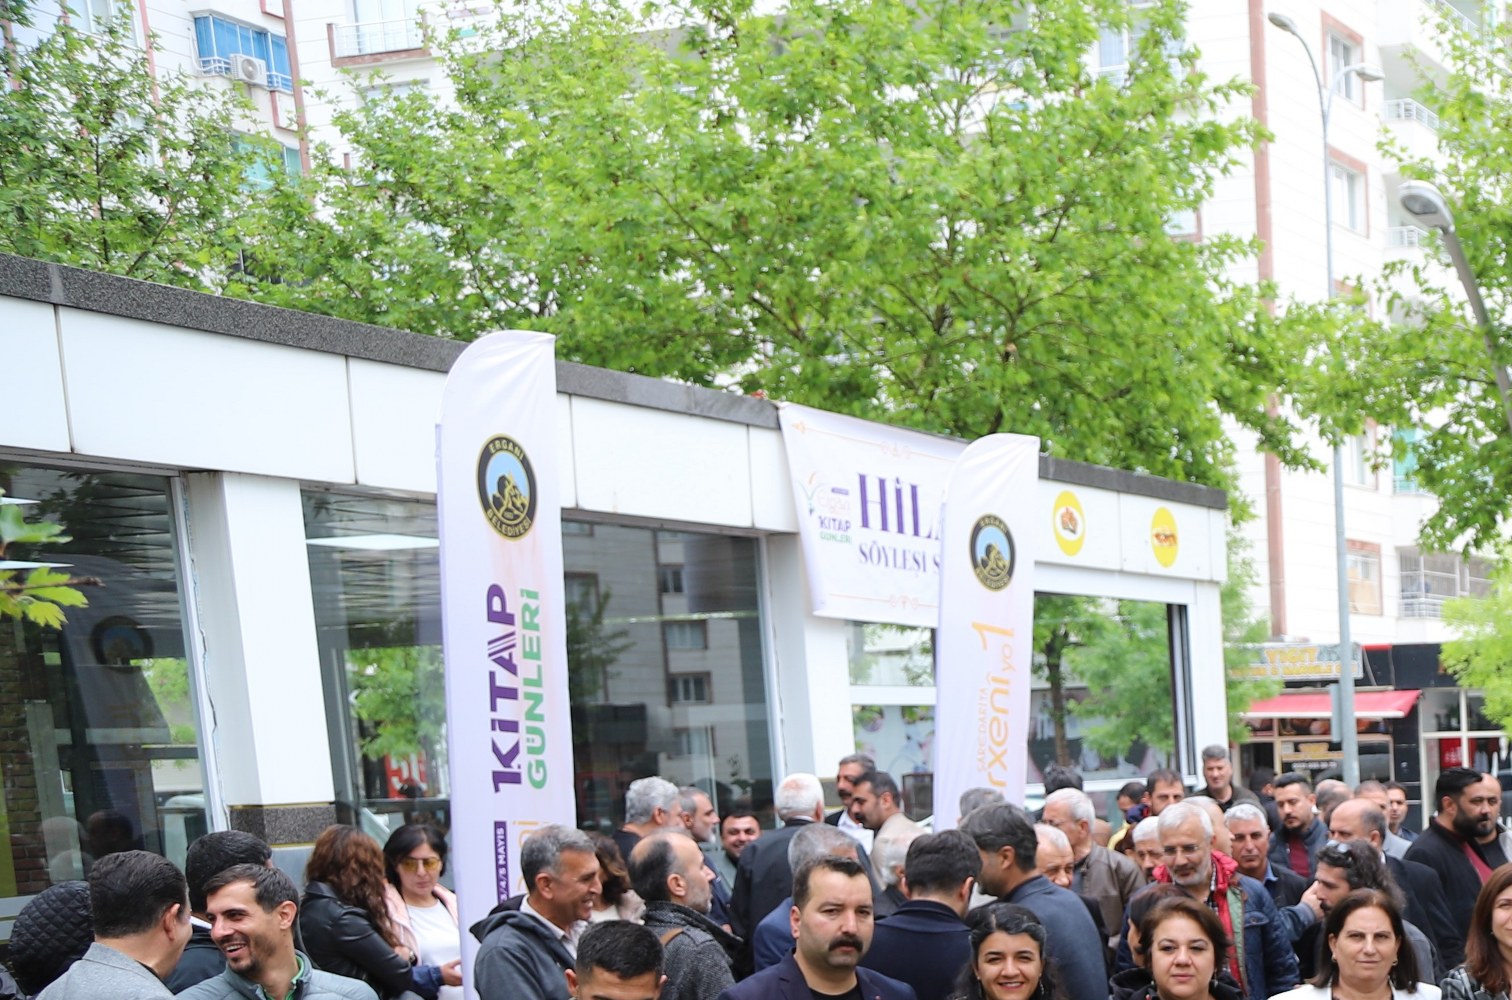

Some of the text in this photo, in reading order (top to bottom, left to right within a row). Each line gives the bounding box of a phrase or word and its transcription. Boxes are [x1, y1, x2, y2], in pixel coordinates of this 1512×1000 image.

[520, 588, 547, 790] GÜNLERİ
[987, 672, 1010, 788] rxenî
[496, 827, 506, 866] MAYIS
